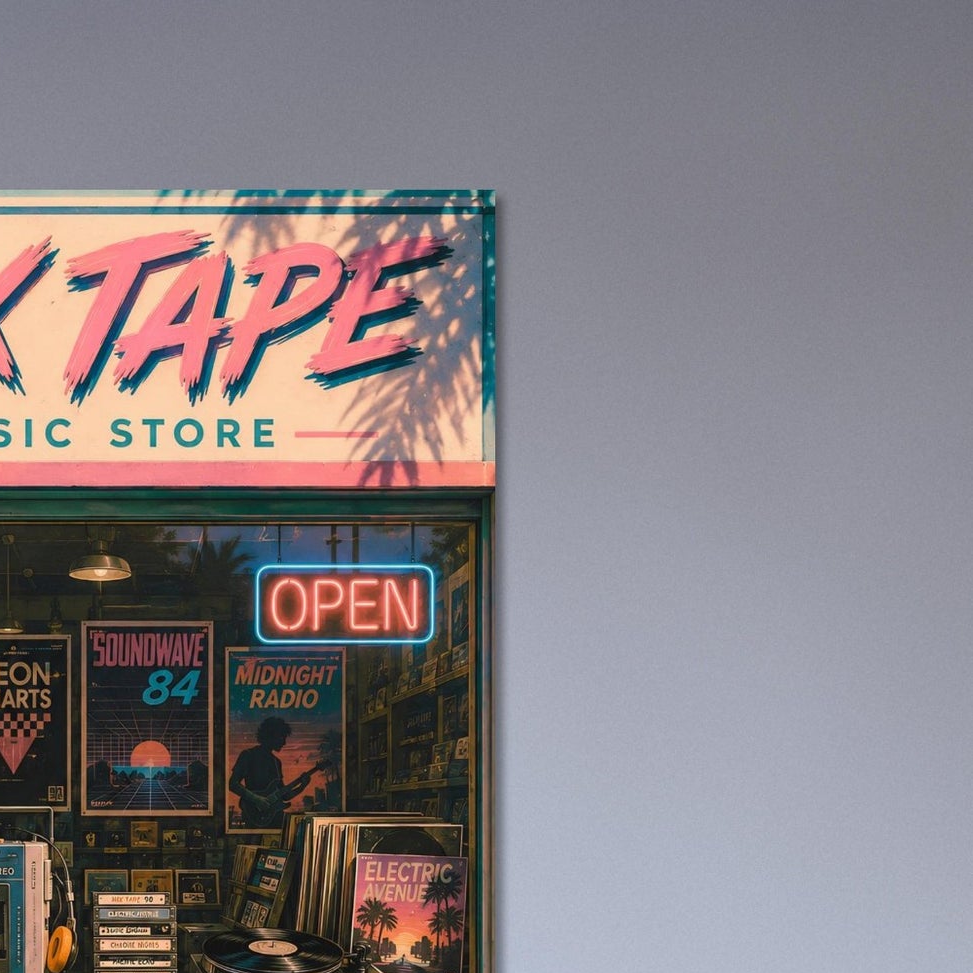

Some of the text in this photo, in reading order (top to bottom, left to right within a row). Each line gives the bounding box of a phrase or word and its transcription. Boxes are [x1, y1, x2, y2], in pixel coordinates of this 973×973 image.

[62, 229, 456, 407] TAPE
[109, 418, 275, 449] STORE
[270, 577, 420, 633] OPEN
[92, 632, 205, 667] SOUNDWAVE
[142, 669, 202, 706] 84
[234, 661, 338, 686] MIDNIGHT
[249, 689, 319, 709] RADIO
[364, 861, 454, 884] ELECTRIC
[363, 883, 429, 902] AVENUE
